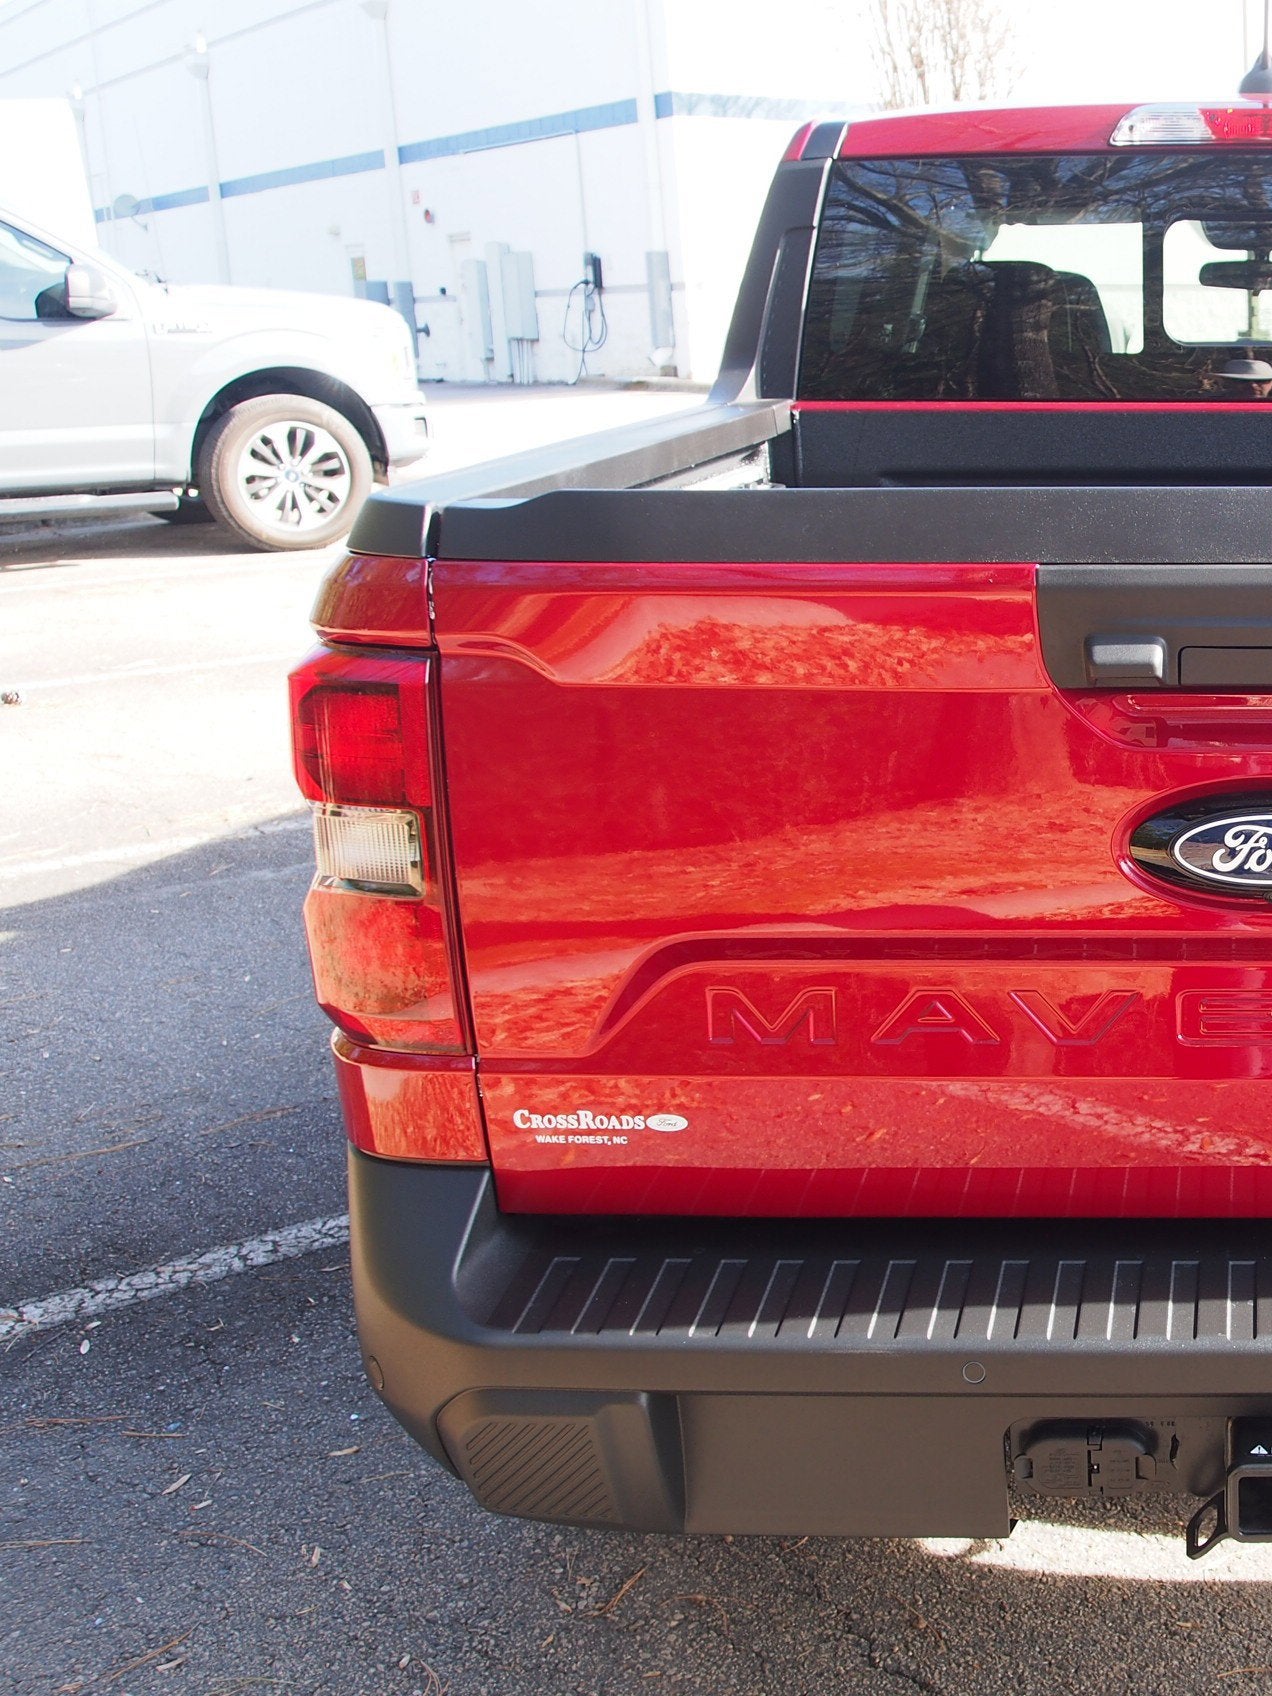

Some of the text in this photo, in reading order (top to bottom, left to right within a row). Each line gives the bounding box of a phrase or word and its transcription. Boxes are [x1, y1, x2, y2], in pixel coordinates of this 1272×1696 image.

[512, 1109, 646, 1131] CROSSROADS
[535, 1135, 629, 1146] WAKE FOREST, NC
